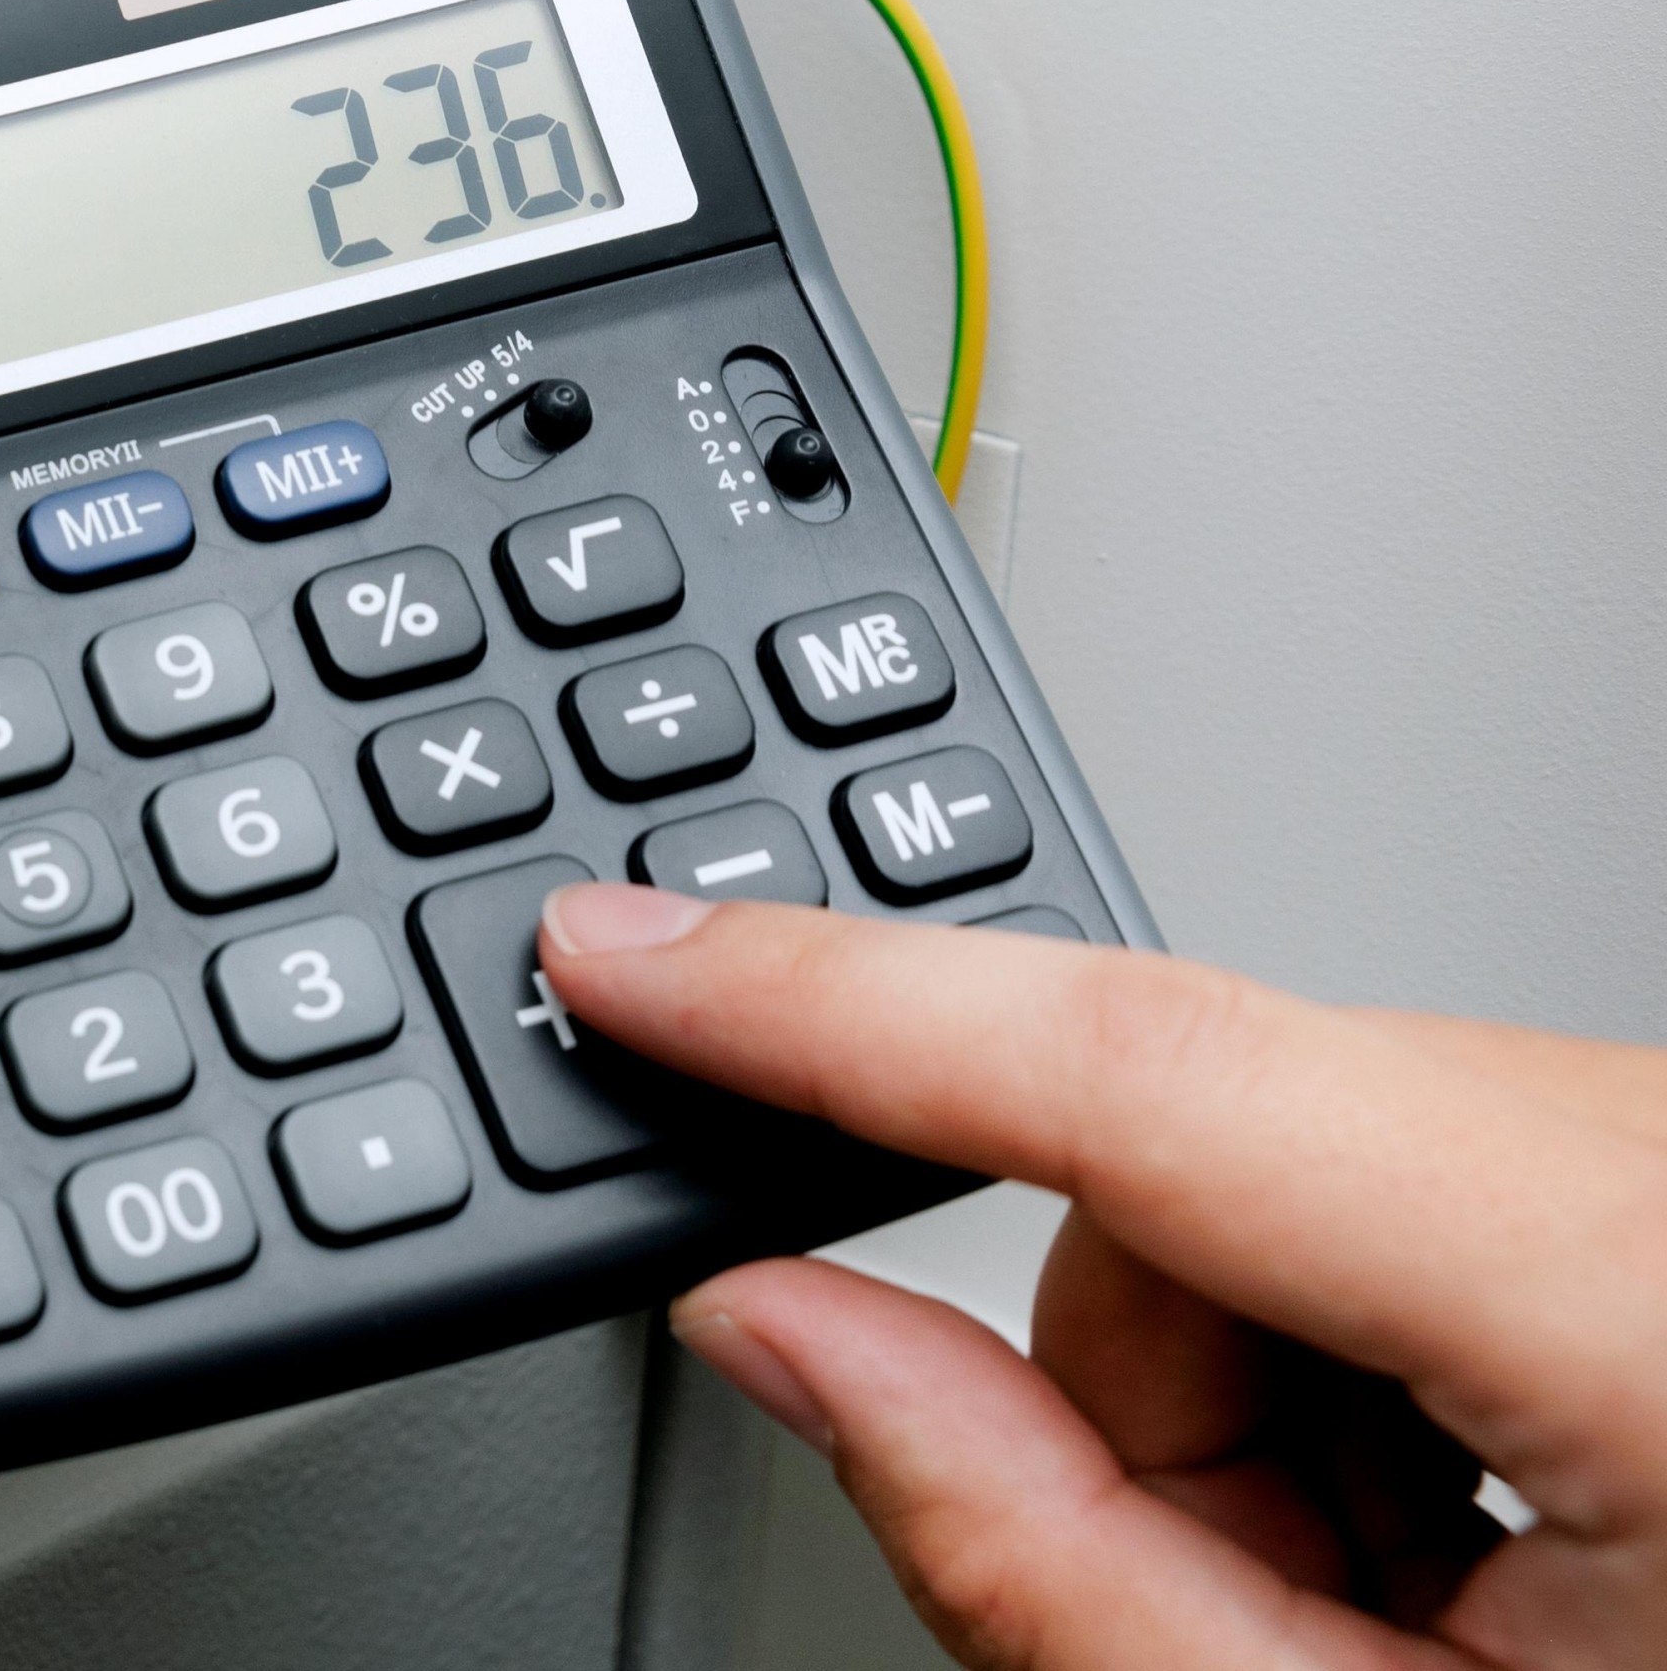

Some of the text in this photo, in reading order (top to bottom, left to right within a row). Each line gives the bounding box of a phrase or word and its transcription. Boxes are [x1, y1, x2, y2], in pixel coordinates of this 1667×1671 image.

[410, 329, 535, 424] CUT UP 5/4
[154, 634, 215, 701] 9
[218, 787, 281, 857] 6
[8, 840, 71, 912] 5
[279, 949, 345, 1021] 3
[70, 1006, 138, 1083] 2
[104, 1167, 223, 1257] 00
